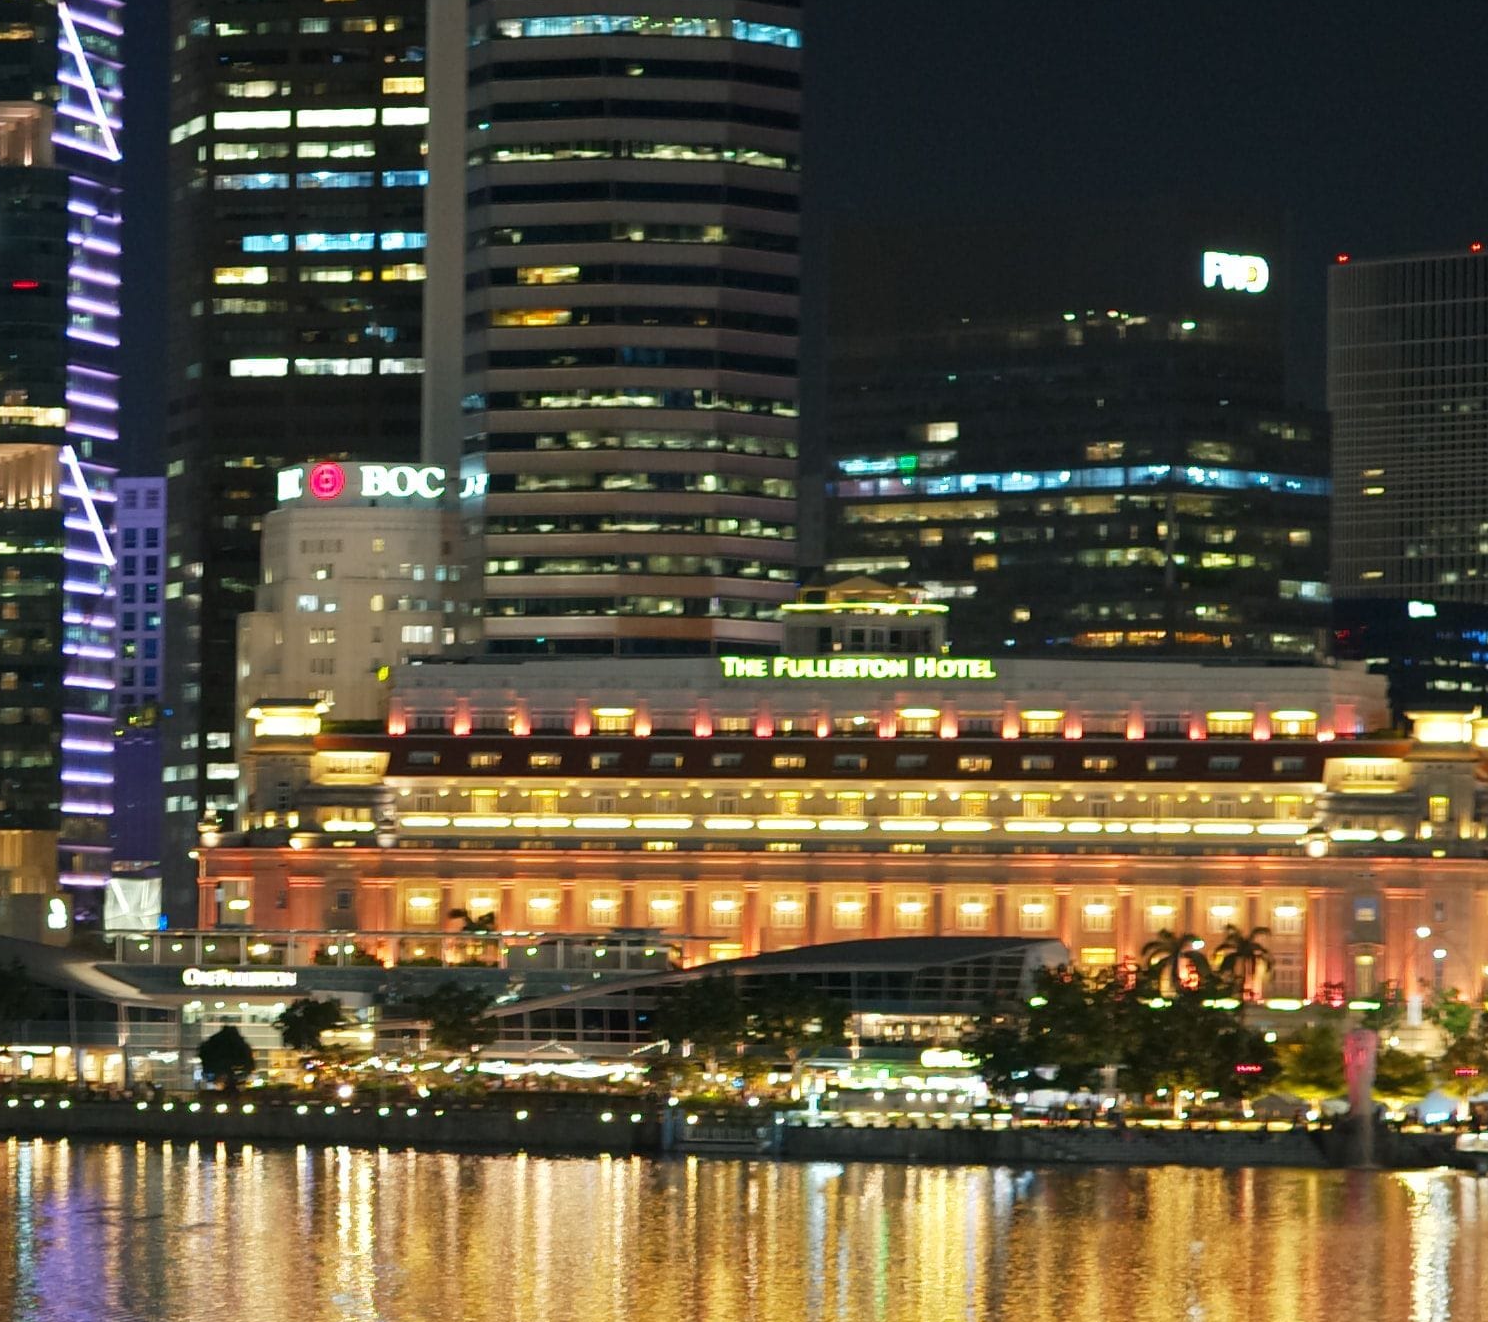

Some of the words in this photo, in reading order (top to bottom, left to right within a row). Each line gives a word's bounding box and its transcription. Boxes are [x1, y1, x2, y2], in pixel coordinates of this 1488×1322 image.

[359, 465, 446, 499] BOC
[720, 656, 767, 678] THE
[773, 657, 908, 678] FULLERTON
[914, 657, 997, 678] HOTEL
